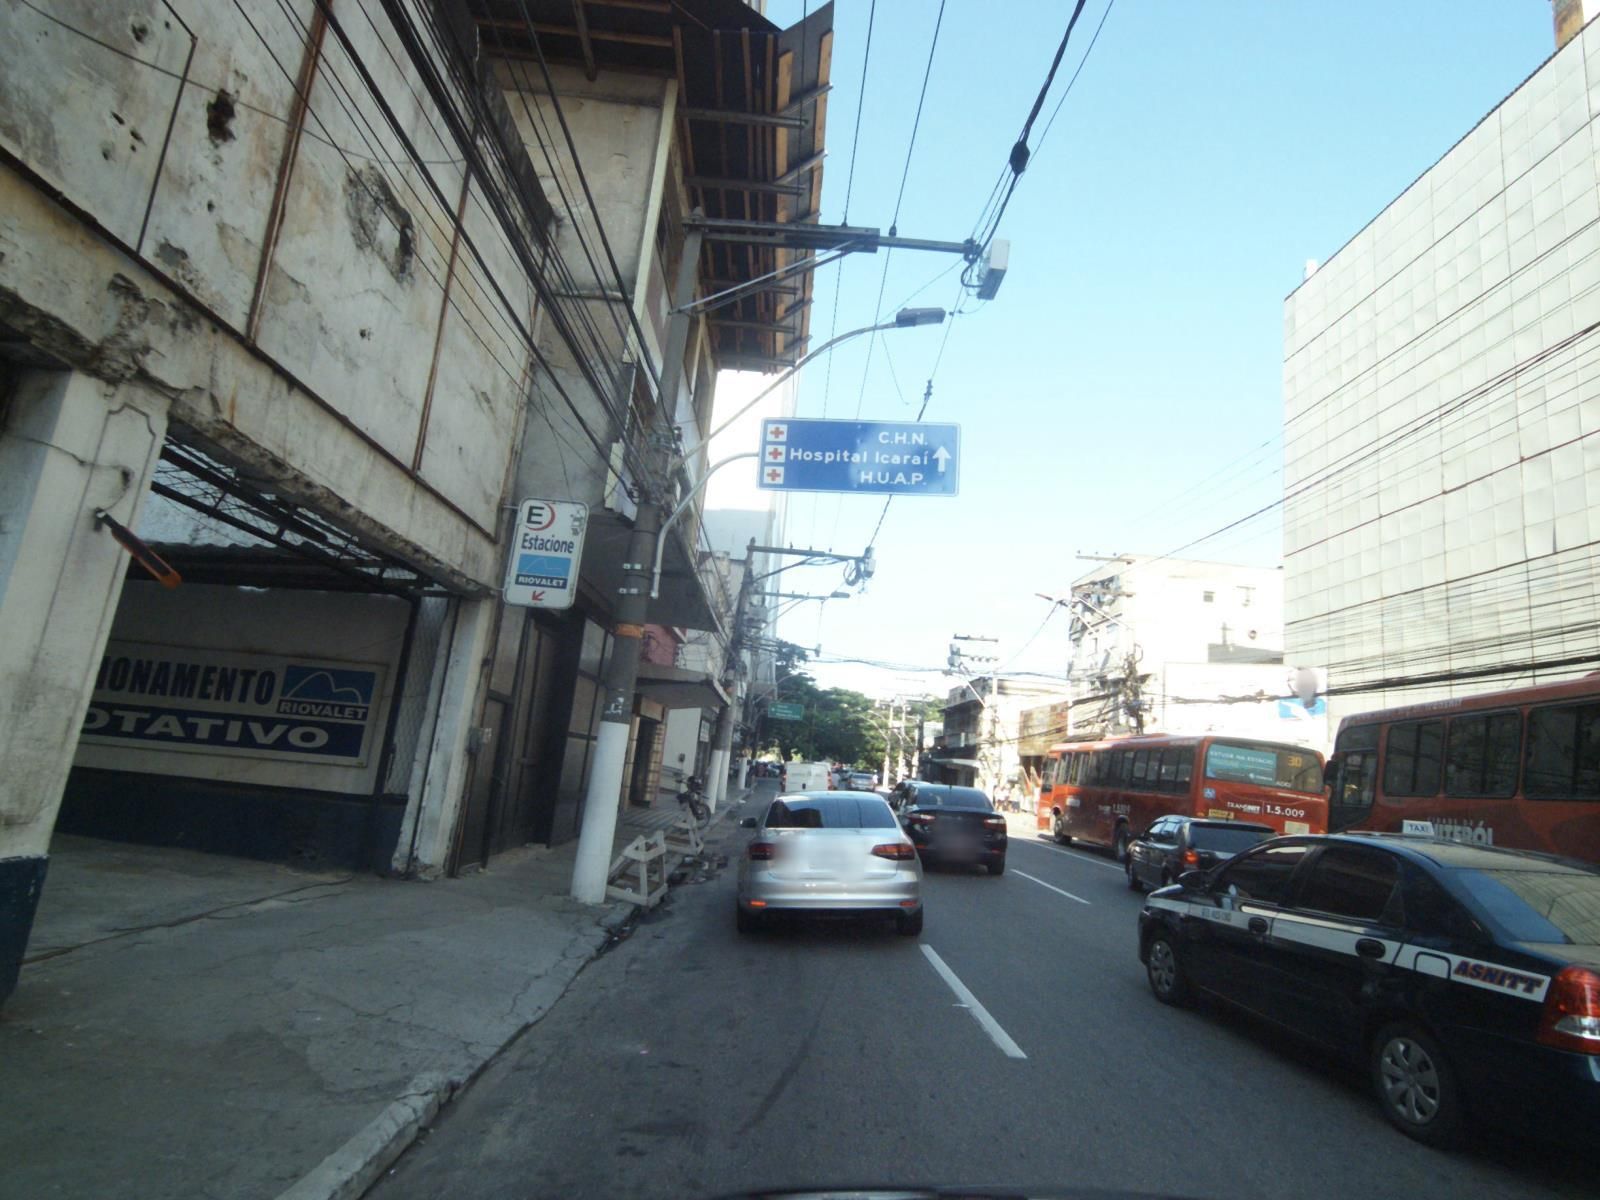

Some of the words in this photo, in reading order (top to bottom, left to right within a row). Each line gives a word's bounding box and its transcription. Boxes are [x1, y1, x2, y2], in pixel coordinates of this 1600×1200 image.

[878, 431, 928, 445] C.H.N.
[790, 448, 867, 464] Hospital
[875, 451, 928, 465] Icaraí
[860, 471, 927, 485] H.U.A.P.
[526, 505, 545, 525] E
[520, 533, 575, 554] Estacione
[518, 576, 564, 586] RIOVALET
[279, 701, 367, 719] RIOVALET
[1265, 804, 1305, 818] 1.5.009
[1409, 824, 1429, 832] TAXI
[1453, 960, 1545, 994] ASNITT
